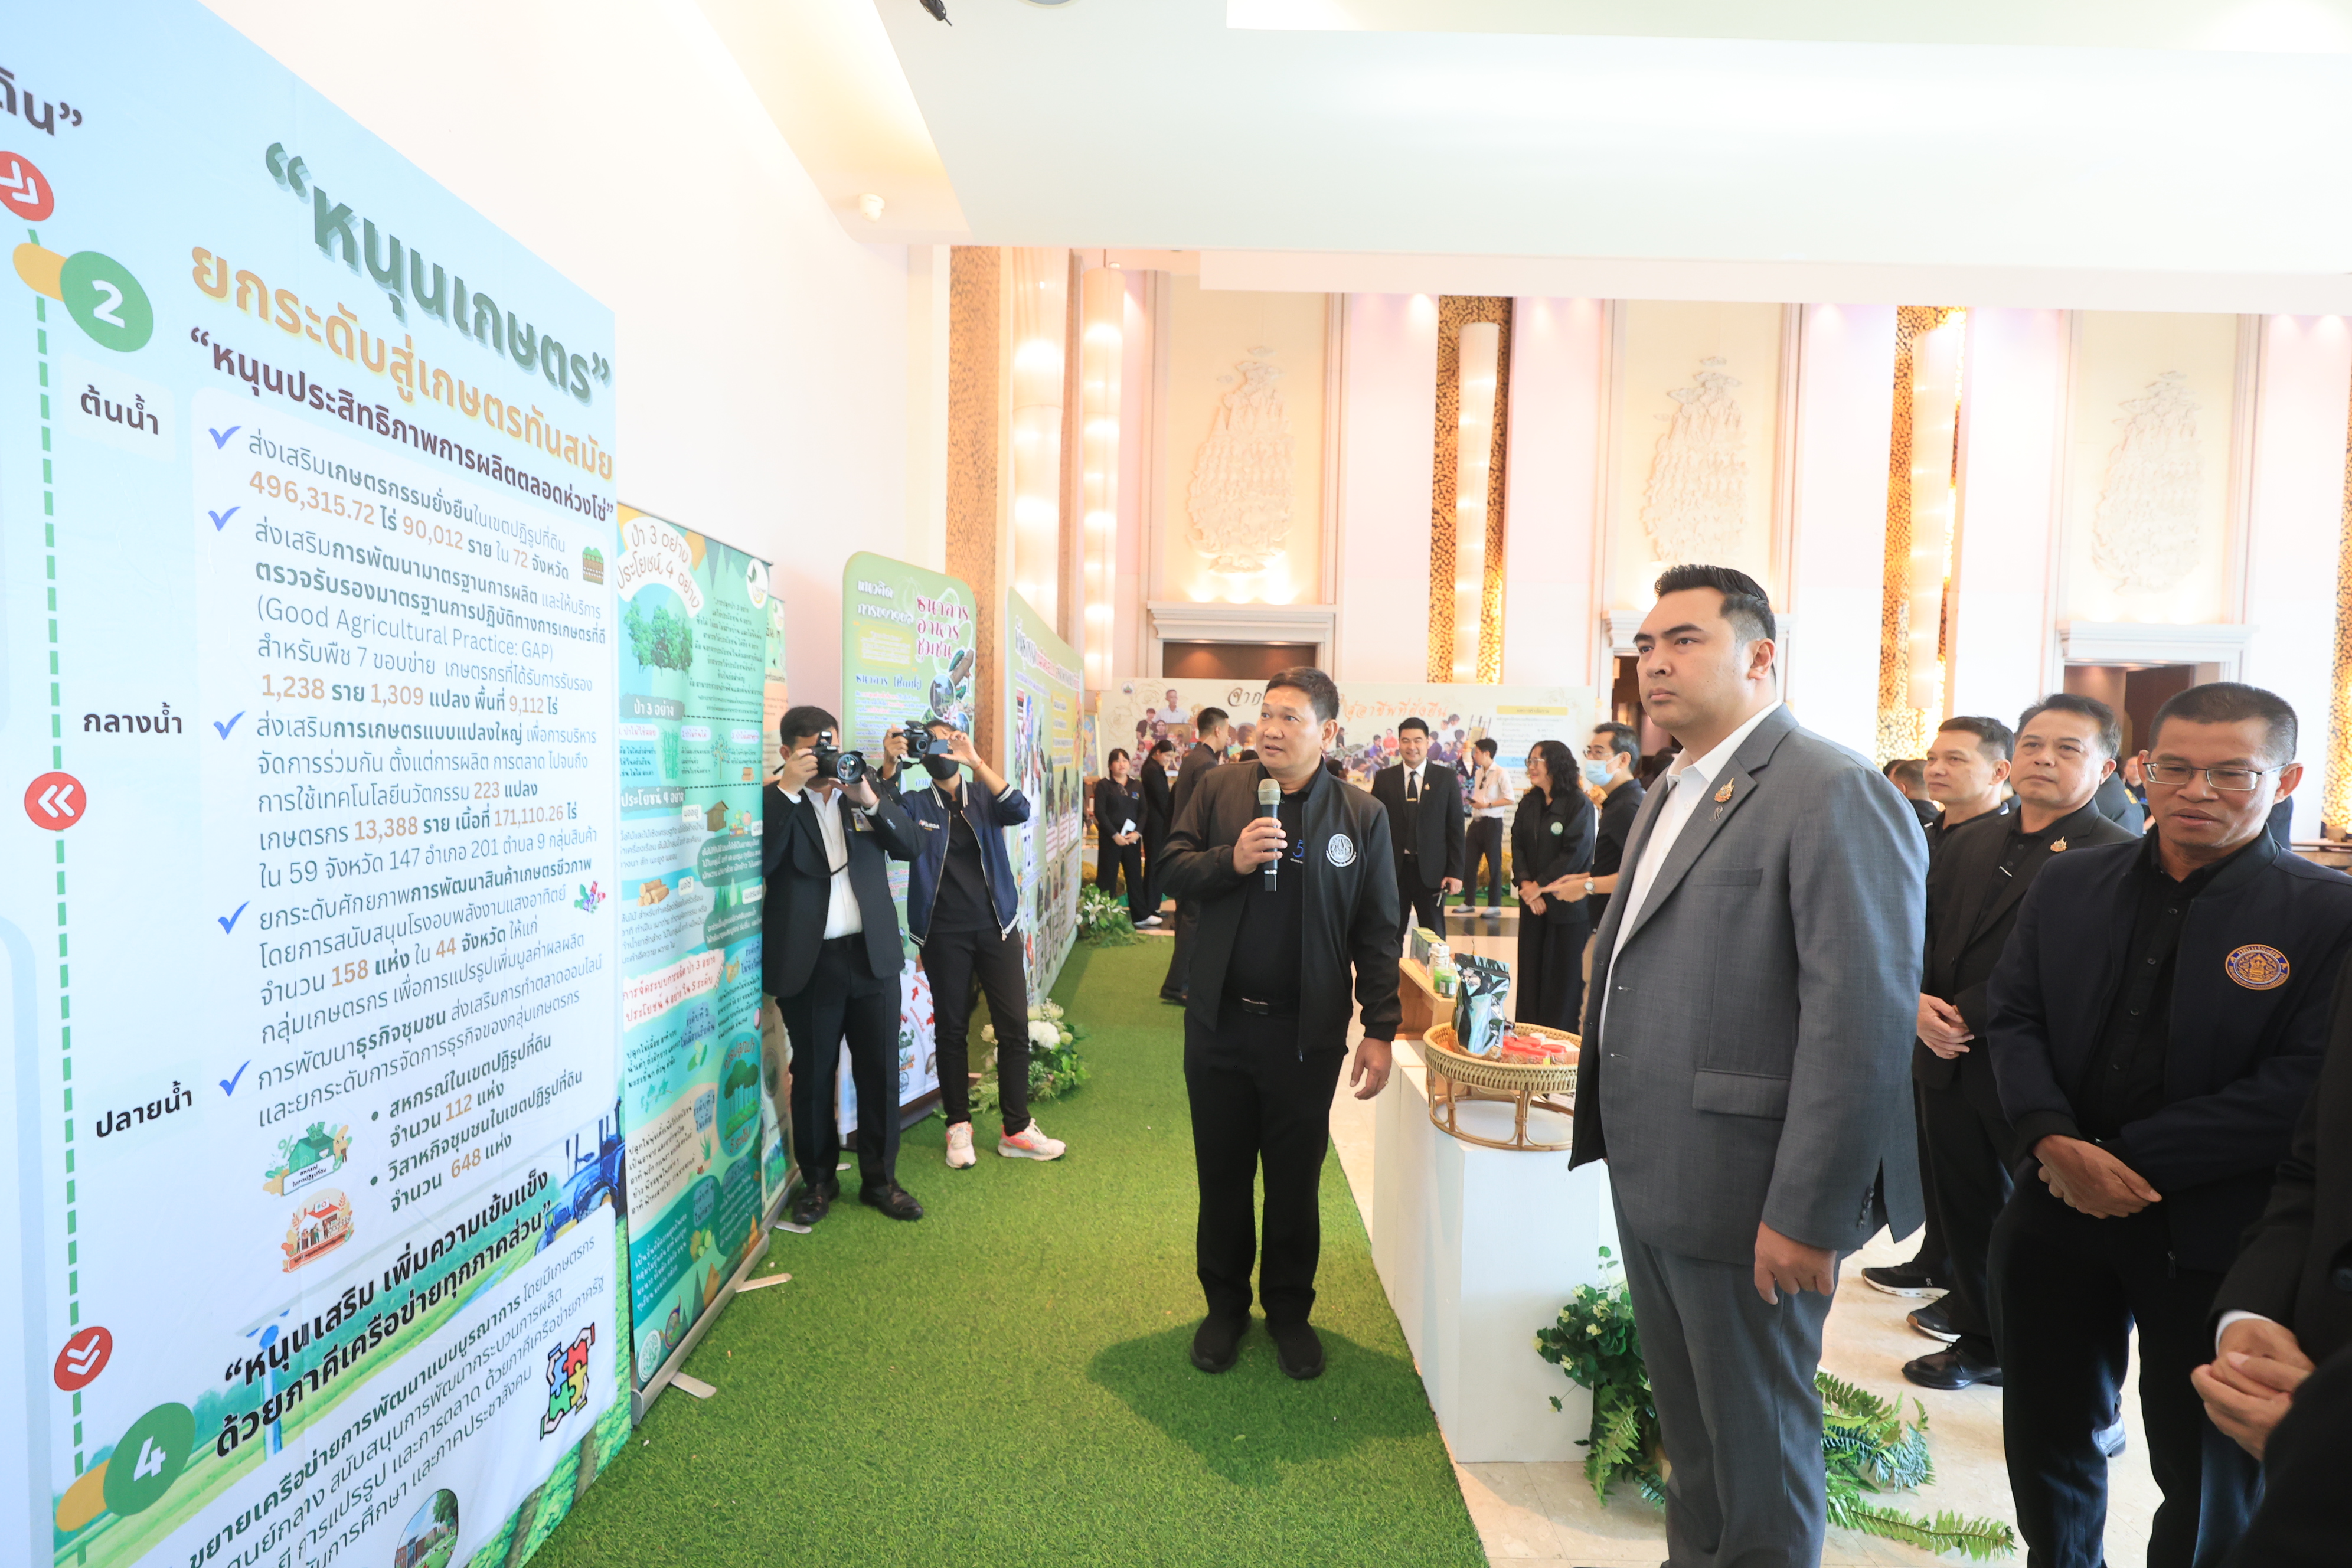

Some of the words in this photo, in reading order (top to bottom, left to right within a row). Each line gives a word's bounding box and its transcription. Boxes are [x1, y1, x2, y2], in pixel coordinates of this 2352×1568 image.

[265, 141, 612, 404] “หนุนเกษตร”
[92, 280, 125, 329] 2
[192, 246, 614, 481] ยกระดับสู่เกษตรทันสมัย
[81, 384, 158, 435] ต้นน้ำ
[249, 471, 374, 525] 496,315.72
[380, 504, 397, 531] ไร่
[403, 515, 463, 550] 90,012
[468, 538, 492, 558] ราย
[496, 540, 509, 563] ใน
[513, 548, 528, 569] 72
[531, 553, 569, 580] จังหวัด
[650, 525, 657, 544] 3
[666, 560, 674, 579] 4
[257, 594, 328, 628] (Good
[336, 609, 447, 646] Agricultural
[453, 628, 517, 664] Practice:
[522, 641, 553, 662] GAP)
[542, 592, 601, 626] และให้บริการ
[917, 596, 969, 621] ธนาคาร
[917, 619, 959, 640] อาหาร
[257, 632, 350, 666] สำหรับพืช
[357, 646, 367, 667] 7
[374, 650, 435, 675] ขอบข่าย
[446, 659, 592, 692] เกษตรกรที่ได้รับการรับรอง
[84, 702, 183, 735] กลางน้ำ
[262, 674, 325, 702] 1,238
[332, 684, 365, 703] ราย
[371, 683, 423, 708] 1,309
[430, 688, 471, 709] แปลง
[475, 684, 505, 711] พื้นที่
[509, 695, 544, 714] 9,112
[547, 695, 558, 715] ไร่
[646, 702, 653, 716] 3
[527, 720, 596, 744] เพื่อการบริหาร
[257, 749, 383, 775] จัดการร่วมกัน
[390, 746, 489, 772] ตั้งแต่การผลิต
[494, 756, 545, 770] การตลาด
[548, 750, 588, 769] ไปจนถึง
[259, 782, 469, 812] การใช้เทคโนโลยีนวัตกรรม
[474, 781, 500, 799] 223
[505, 779, 538, 798] แปลง
[621, 787, 662, 807] ประโยชน์
[260, 825, 348, 851] เกษตรกร
[355, 816, 418, 844] 13,388
[423, 817, 450, 834] ราย
[494, 805, 563, 827] 171,110.26
[566, 801, 577, 820] ไร่
[259, 862, 281, 889] ใน
[290, 860, 318, 884] 59
[325, 852, 383, 880] จังหวัด
[390, 847, 420, 870] 147
[425, 844, 466, 865] อำเภอ
[471, 838, 499, 859] 201
[503, 835, 533, 854] ตำบล
[537, 832, 545, 850] 9
[549, 825, 597, 851] กลุ่มสินค้า
[260, 974, 325, 1006] จำนวน
[332, 959, 368, 988] 158
[375, 947, 410, 976] แห่ง
[414, 942, 430, 965] ใน
[436, 937, 457, 958] 44
[461, 926, 506, 952] จังหวัด
[509, 914, 537, 940] ให้แก่
[258, 1010, 446, 1090] การพัฒนาธุรกิจชุมชน
[451, 953, 602, 1021] ส่งเสริมการทำตลาดออนไลน์
[262, 991, 388, 1044] กลุ่มเกษตรกร
[389, 1032, 551, 1119] สหกรณ์ในเขตปฏิรูปที่ดิน
[96, 1080, 194, 1138] ปลายน้ำ
[390, 1111, 441, 1149] จำนวน
[446, 1093, 472, 1122] 112
[477, 1079, 504, 1106] แห่ง
[390, 1172, 442, 1213] จำนวน
[451, 1148, 481, 1178] 648
[485, 1131, 512, 1160] แห่ง
[225, 1281, 374, 1386] “หนุนเสริม
[384, 1169, 548, 1292] เพิ่มความเข้มแข็ง
[523, 1236, 594, 1302] โดยมีเกษตรกร
[298, 1461, 386, 1559] การแปรรูป
[393, 1385, 481, 1474] และการตลาด
[485, 1276, 604, 1391] ด้วยภาคีเครือข่ายภาครัฐ
[413, 1366, 531, 1487] และภาคประชาสังคม
[133, 1437, 166, 1482] 4
